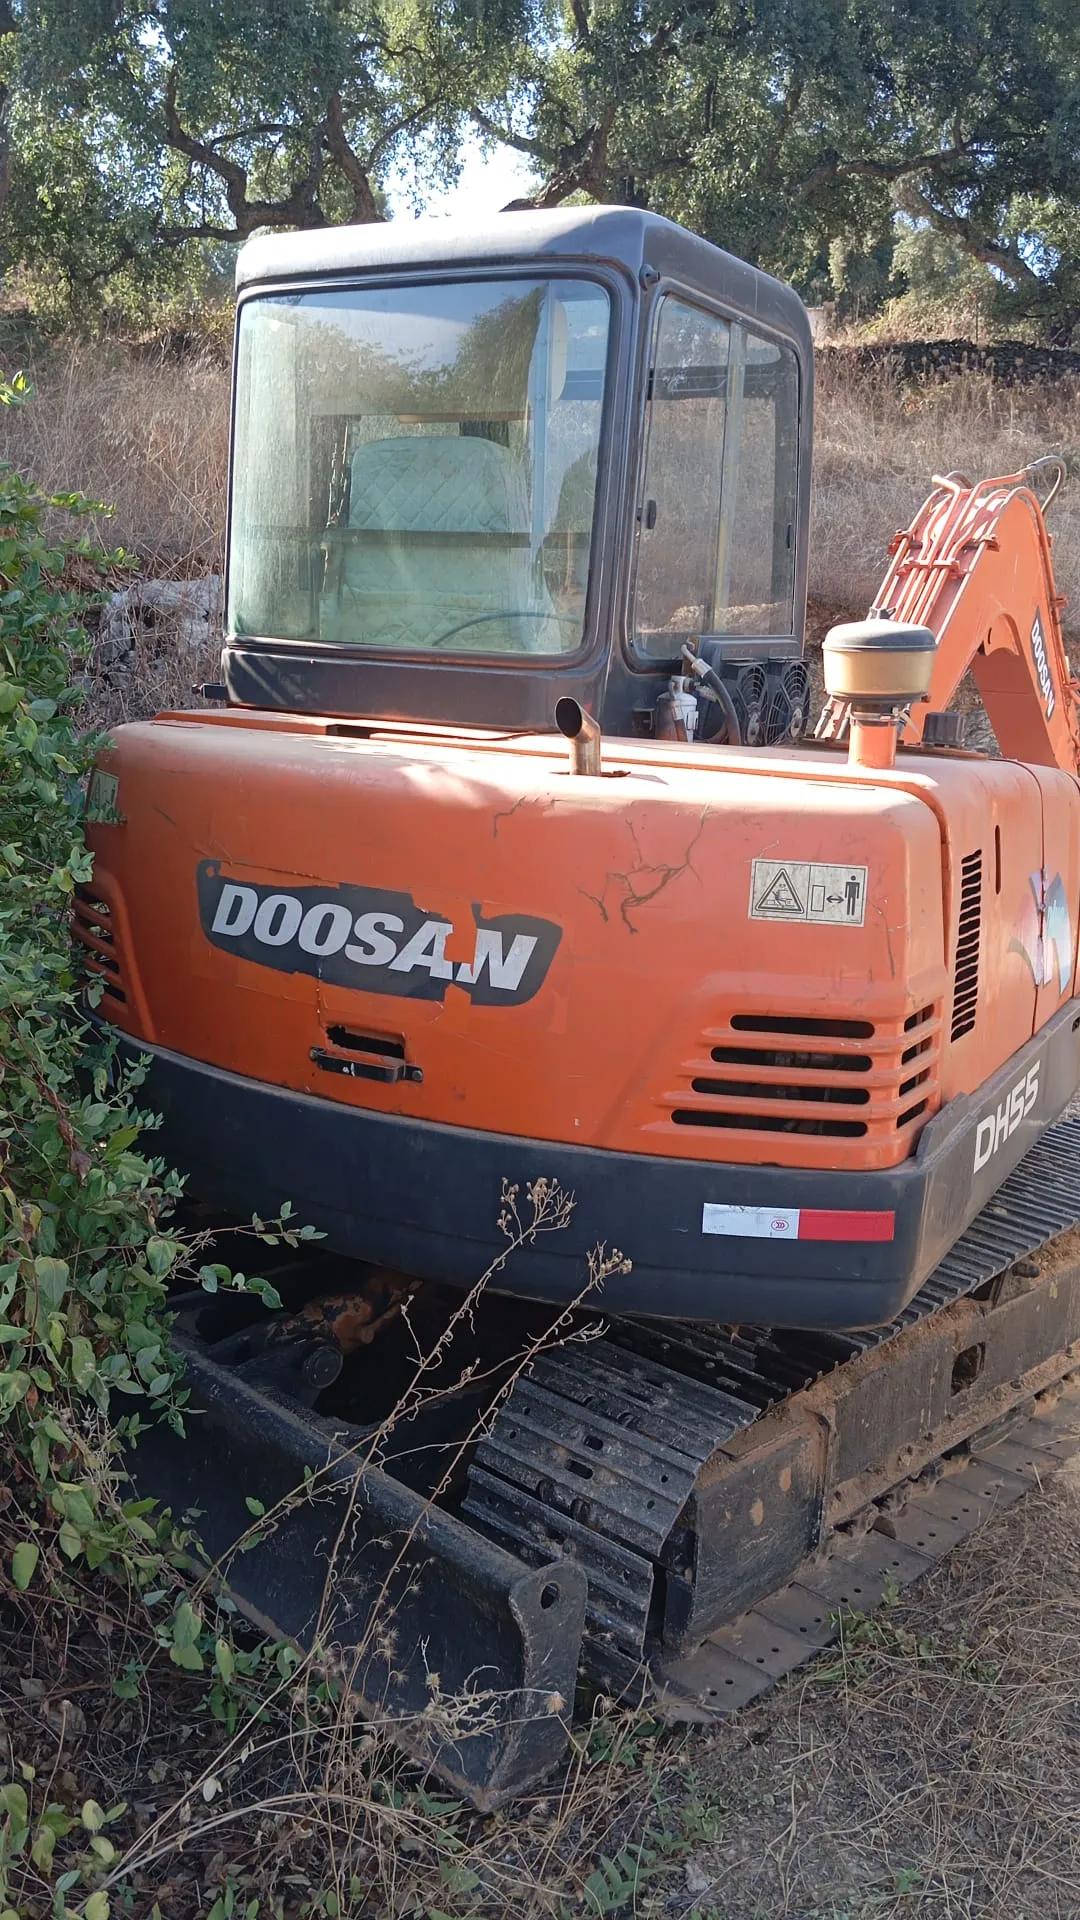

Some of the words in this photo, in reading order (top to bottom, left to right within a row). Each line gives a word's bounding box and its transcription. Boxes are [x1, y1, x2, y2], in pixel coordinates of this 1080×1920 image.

[1032, 617, 1055, 718] DOOSAN
[211, 884, 538, 991] DOOSAN
[973, 1059, 1041, 1175] DH55
